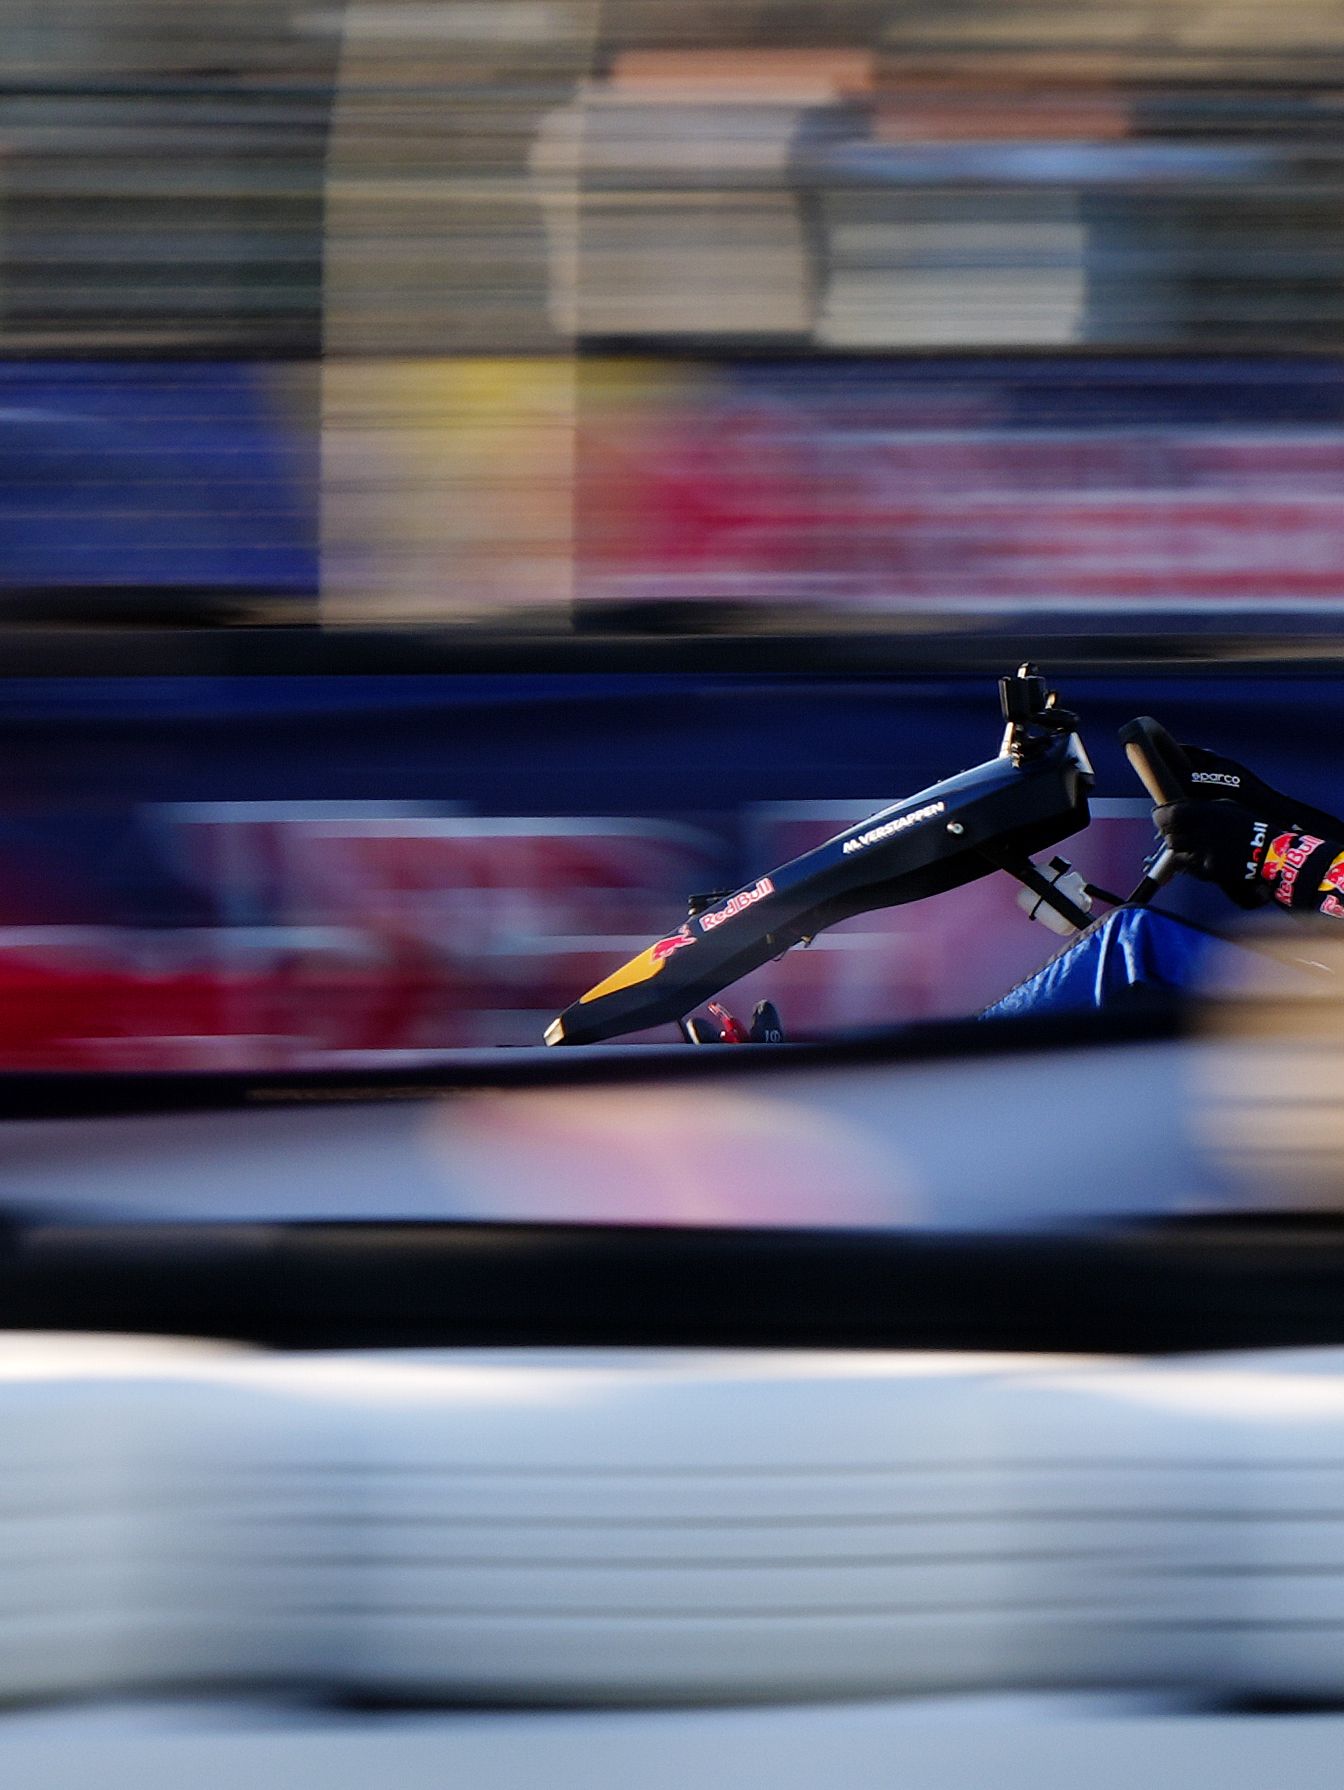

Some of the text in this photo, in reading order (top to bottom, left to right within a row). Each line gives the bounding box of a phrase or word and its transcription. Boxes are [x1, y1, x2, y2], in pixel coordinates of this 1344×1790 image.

[1191, 772, 1240, 786] sparco
[1245, 822, 1268, 879] Mobil
[699, 877, 775, 931] Red Bull
